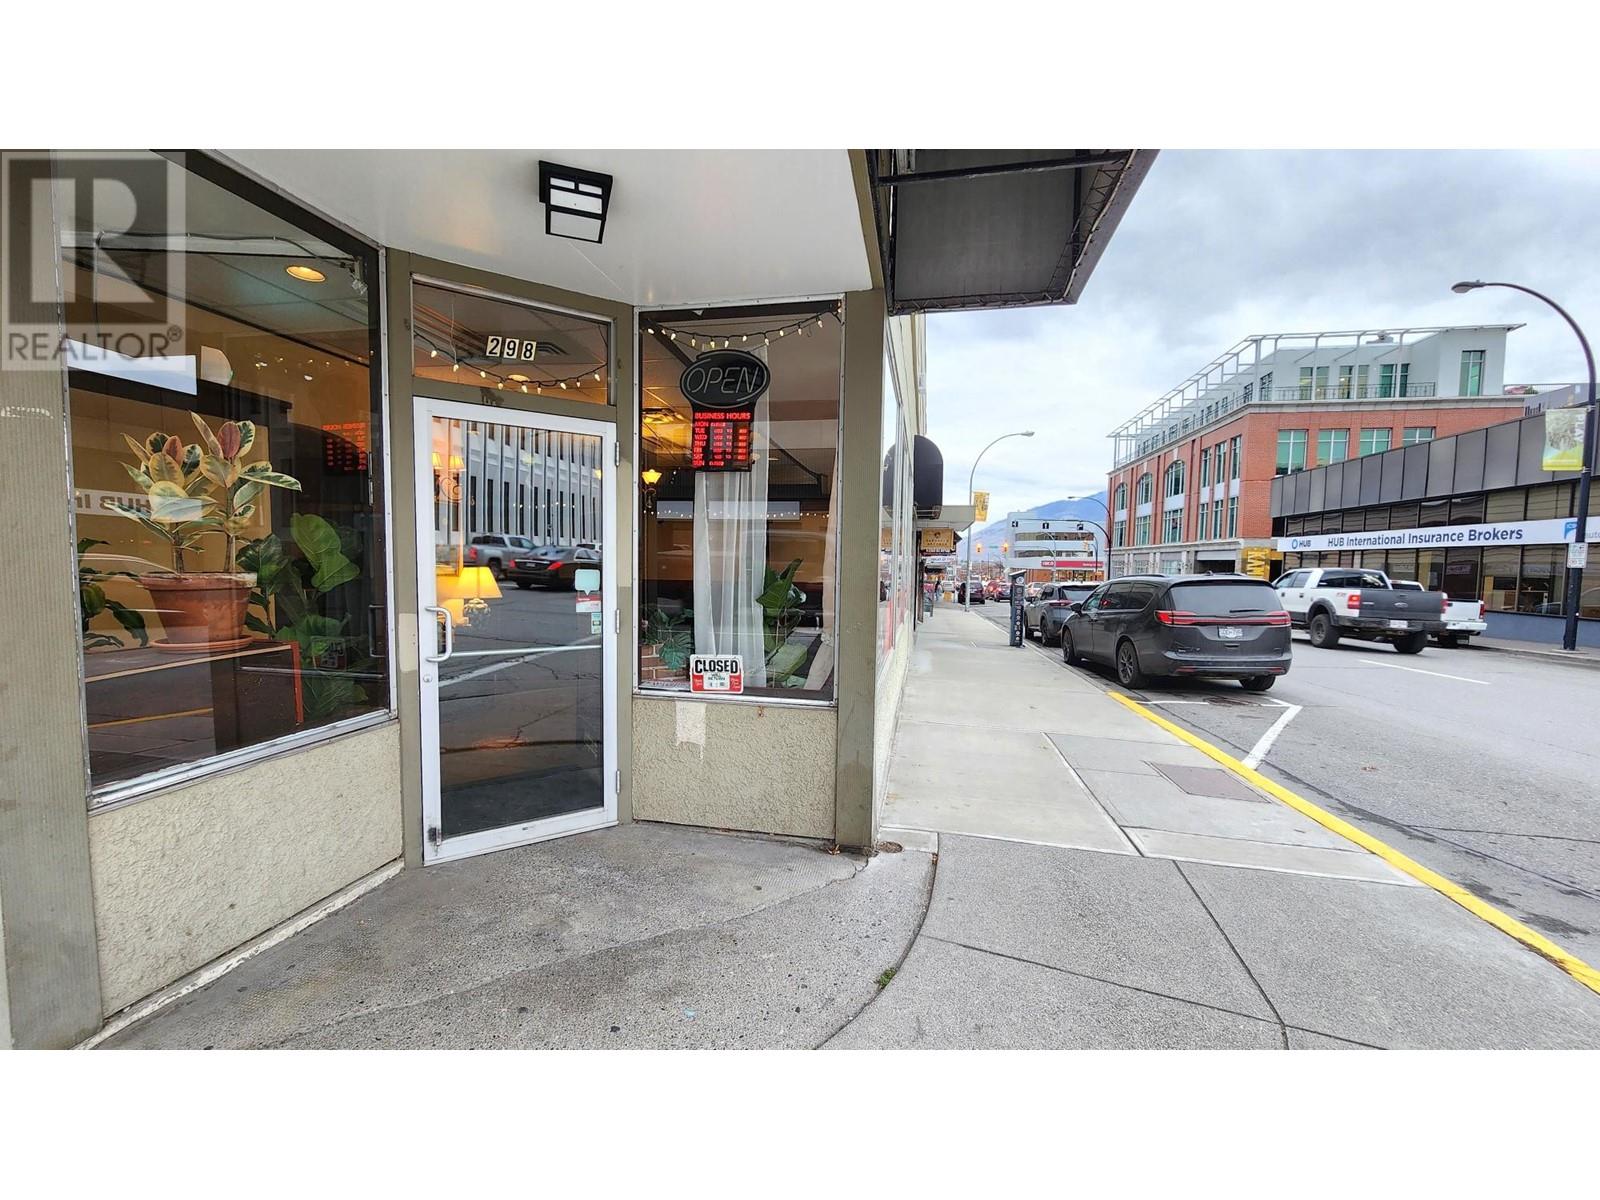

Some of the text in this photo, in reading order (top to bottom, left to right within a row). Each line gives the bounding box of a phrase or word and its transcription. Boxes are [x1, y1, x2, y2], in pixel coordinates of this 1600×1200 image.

[488, 337, 534, 359] 298
[686, 366, 760, 394] OPEN
[694, 412, 751, 420] BUSINESS HOURS
[1298, 539, 1312, 548] HUB
[1327, 527, 1523, 547] HUB International Insurance Brokers
[694, 659, 738, 674] CLOSED
